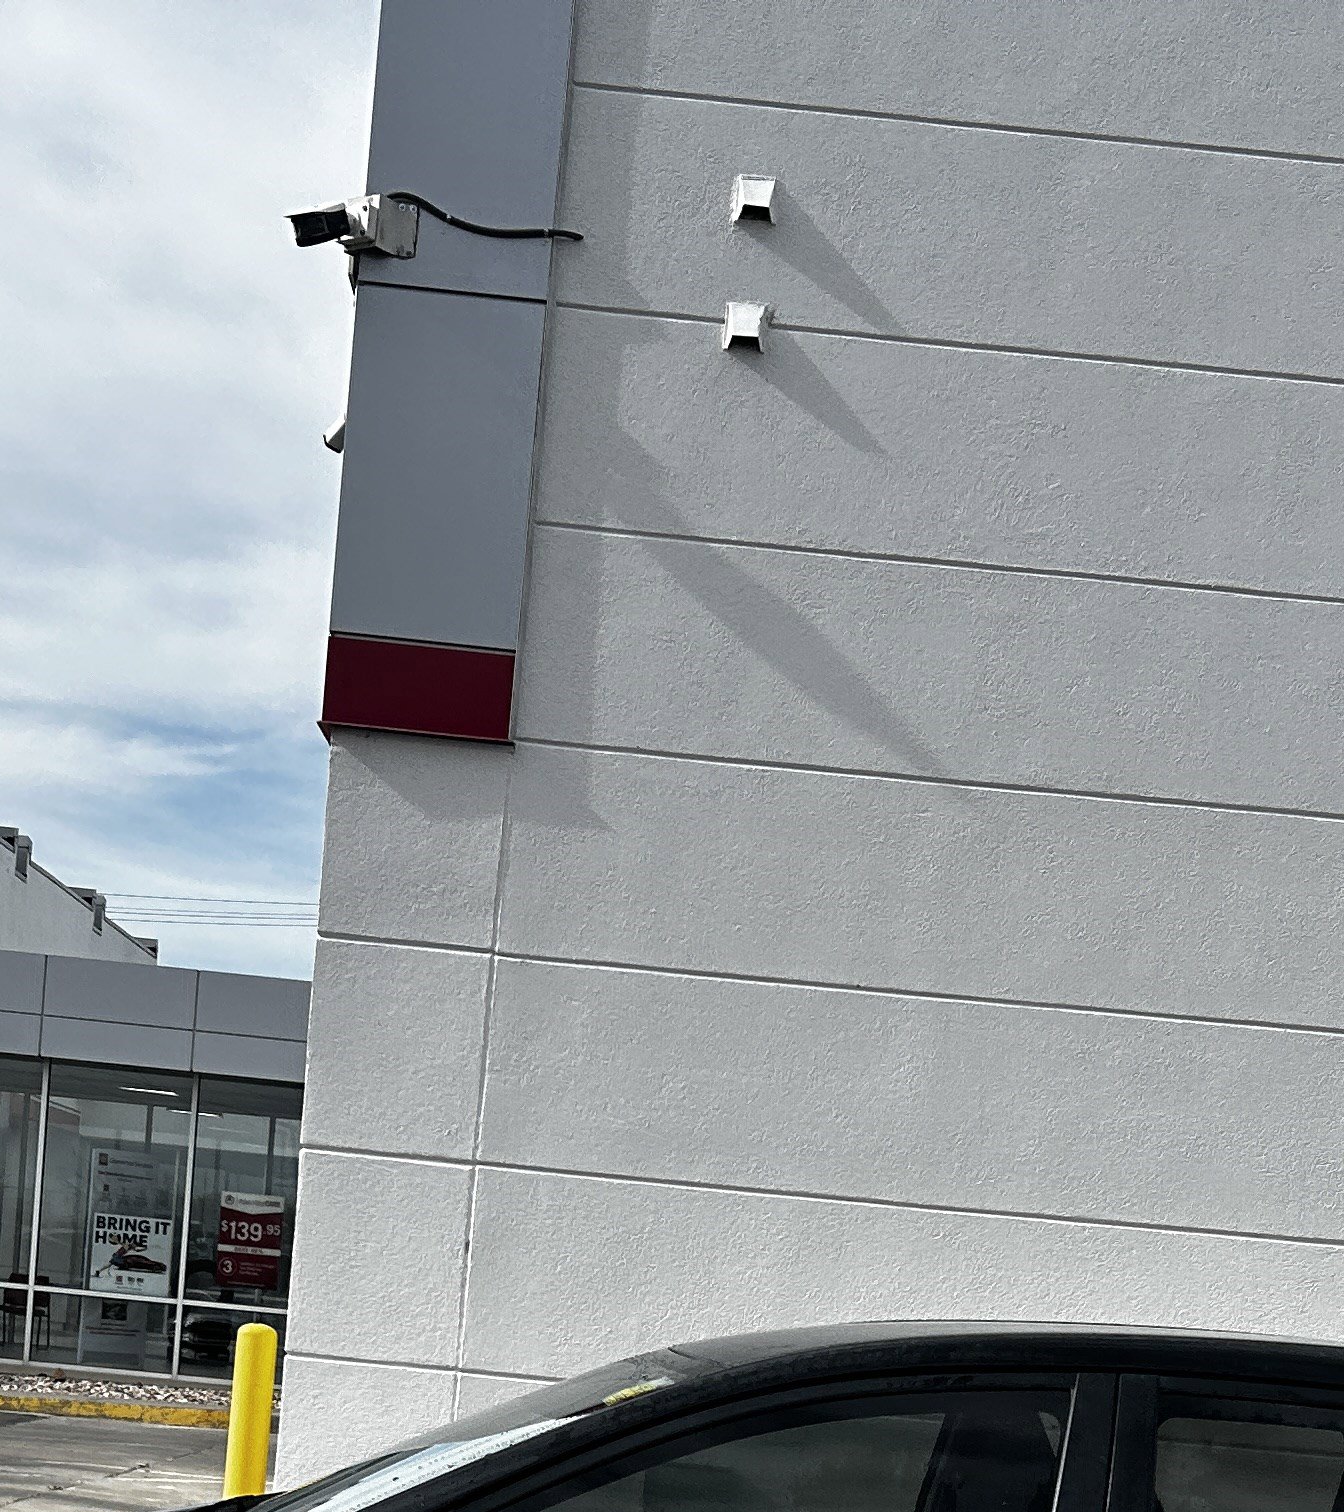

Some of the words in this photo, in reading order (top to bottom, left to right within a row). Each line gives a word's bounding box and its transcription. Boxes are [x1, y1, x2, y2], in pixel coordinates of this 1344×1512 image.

[96, 1215, 150, 1234] BRING
[155, 1221, 171, 1235] IT
[221, 1220, 281, 1242] $139.95
[95, 1231, 148, 1248] HOME
[222, 1260, 233, 1273] 3
